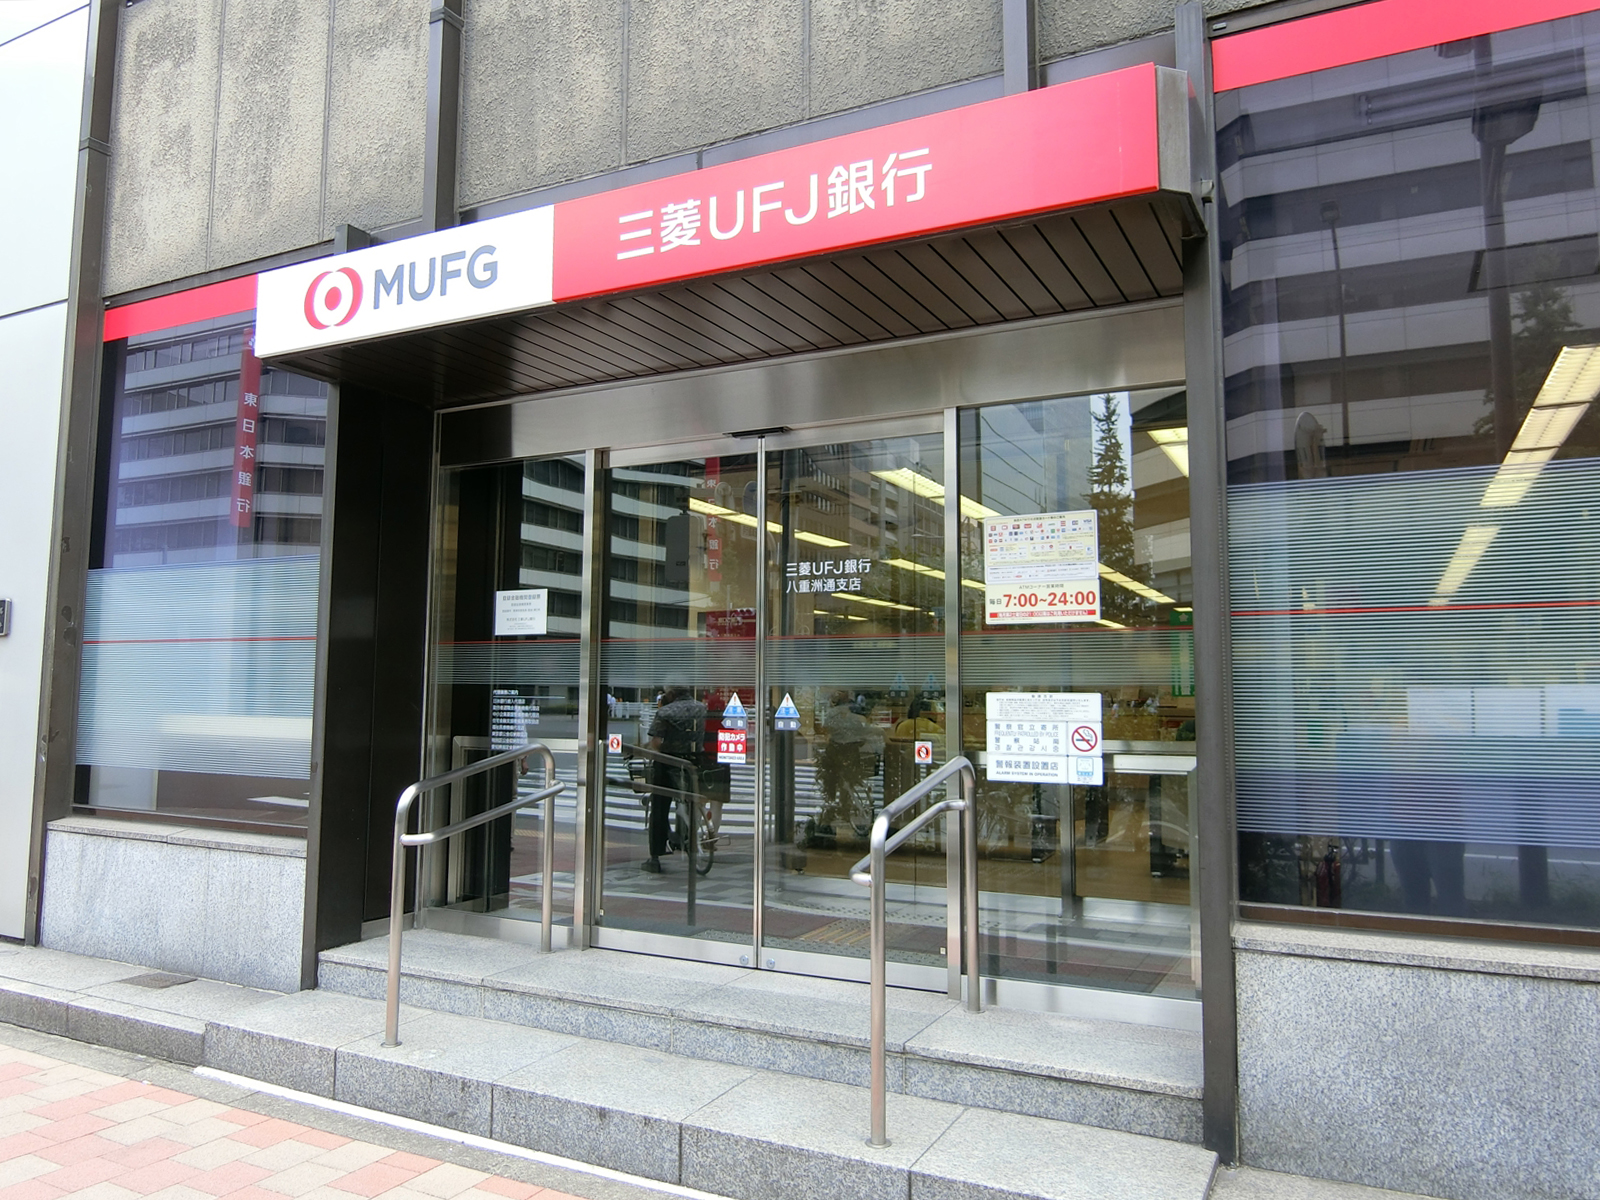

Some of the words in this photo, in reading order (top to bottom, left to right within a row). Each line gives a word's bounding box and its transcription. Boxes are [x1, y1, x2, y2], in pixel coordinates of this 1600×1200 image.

[617, 148, 933, 260] 三菱UFJ銀行
[373, 245, 498, 310] MUFG
[786, 558, 872, 577] 三菱UFJ銀行
[786, 577, 862, 594] 八重洲通支店
[995, 760, 1059, 771] 警報装置設置店
